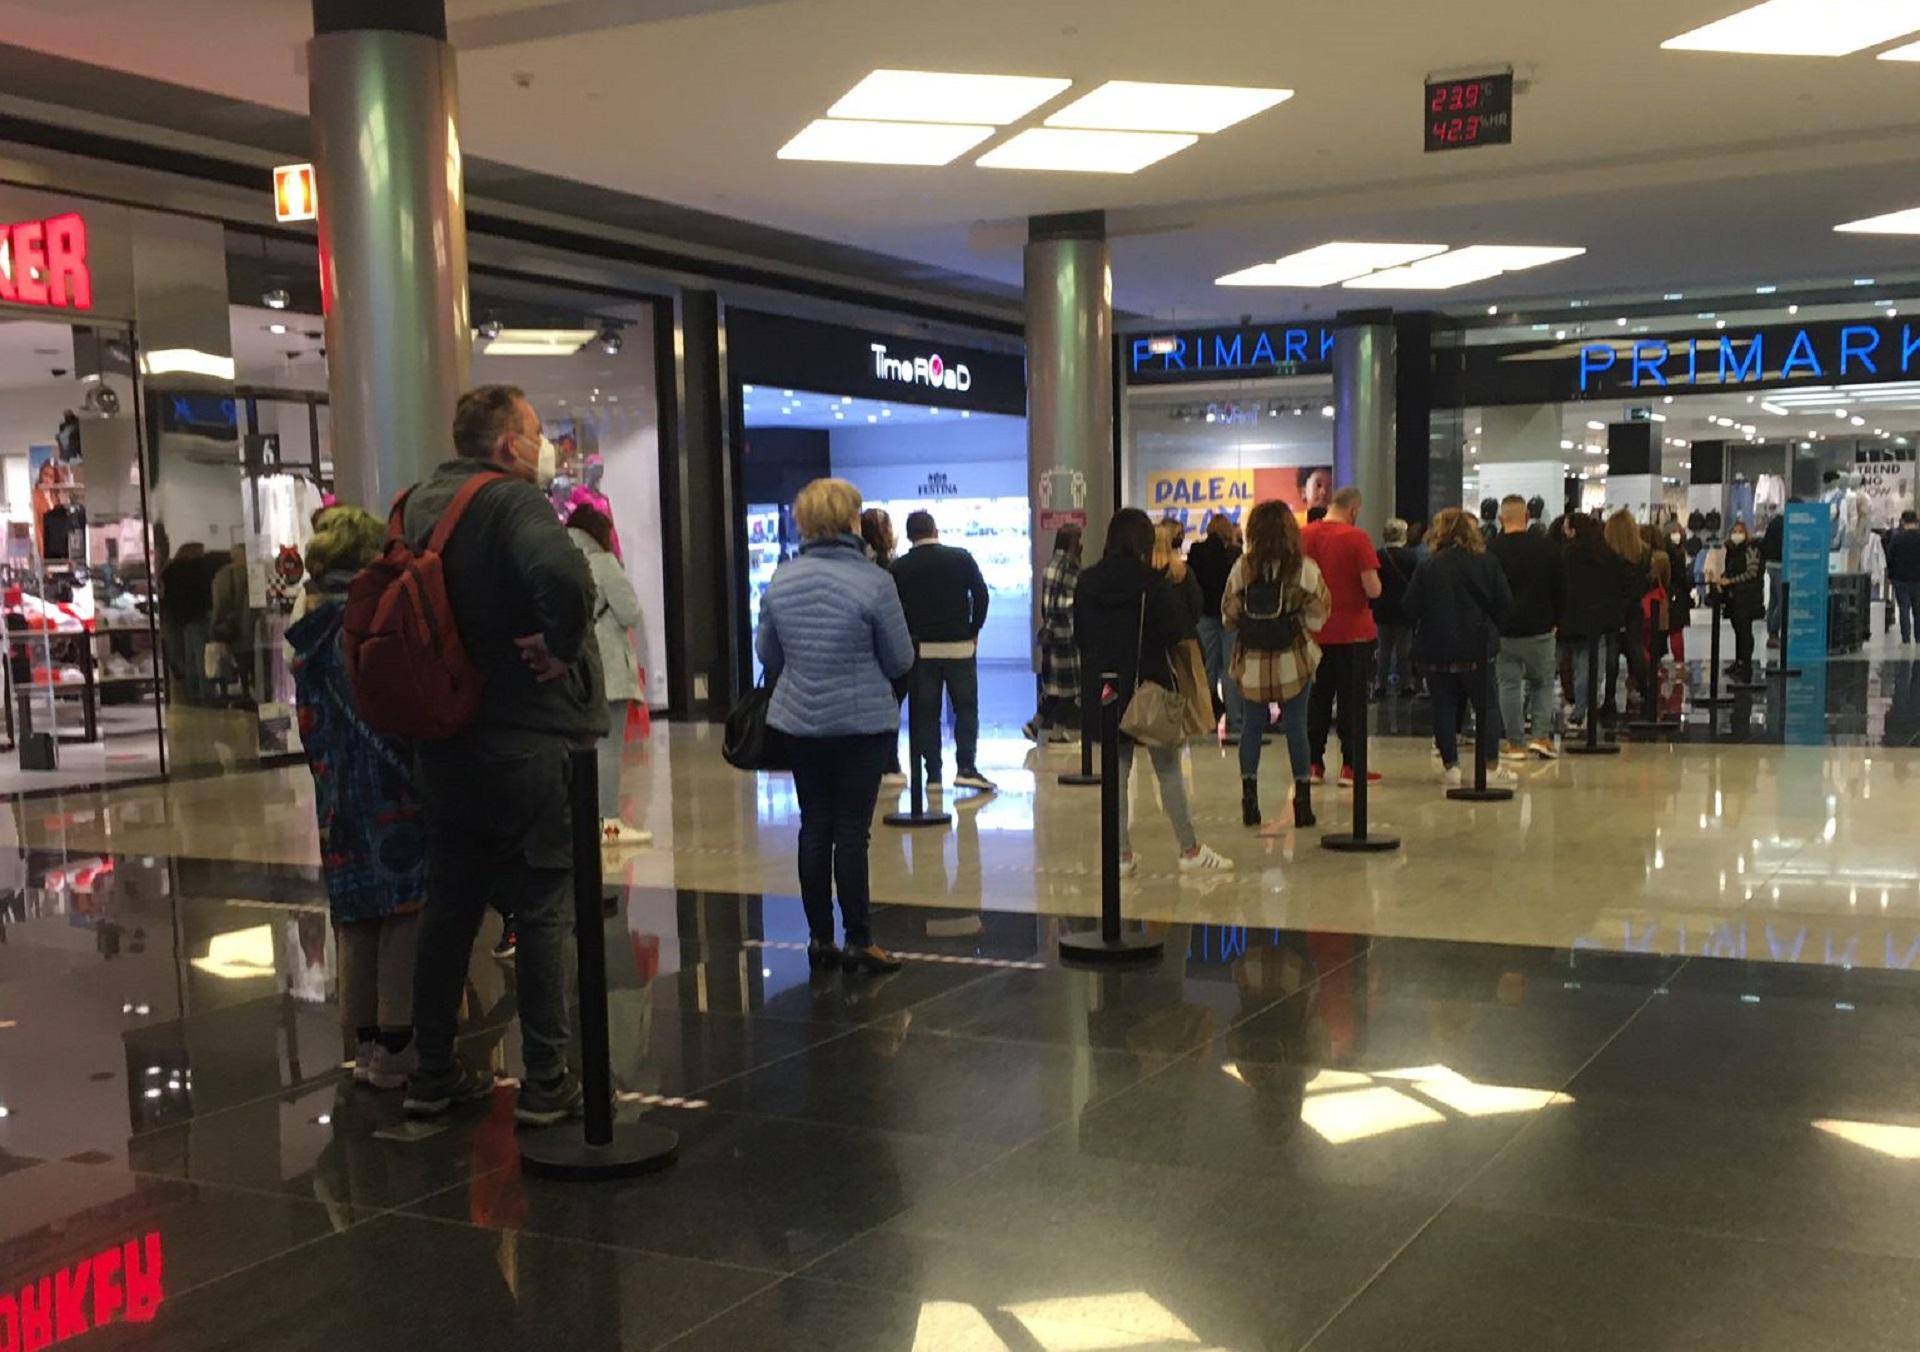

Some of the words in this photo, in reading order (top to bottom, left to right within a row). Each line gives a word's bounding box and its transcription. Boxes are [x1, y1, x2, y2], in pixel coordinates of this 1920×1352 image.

[1858, 464, 1900, 474] TREND
[918, 483, 958, 496] FESTINA
[1155, 478, 1225, 504] DALE
[1228, 481, 1252, 500] AL
